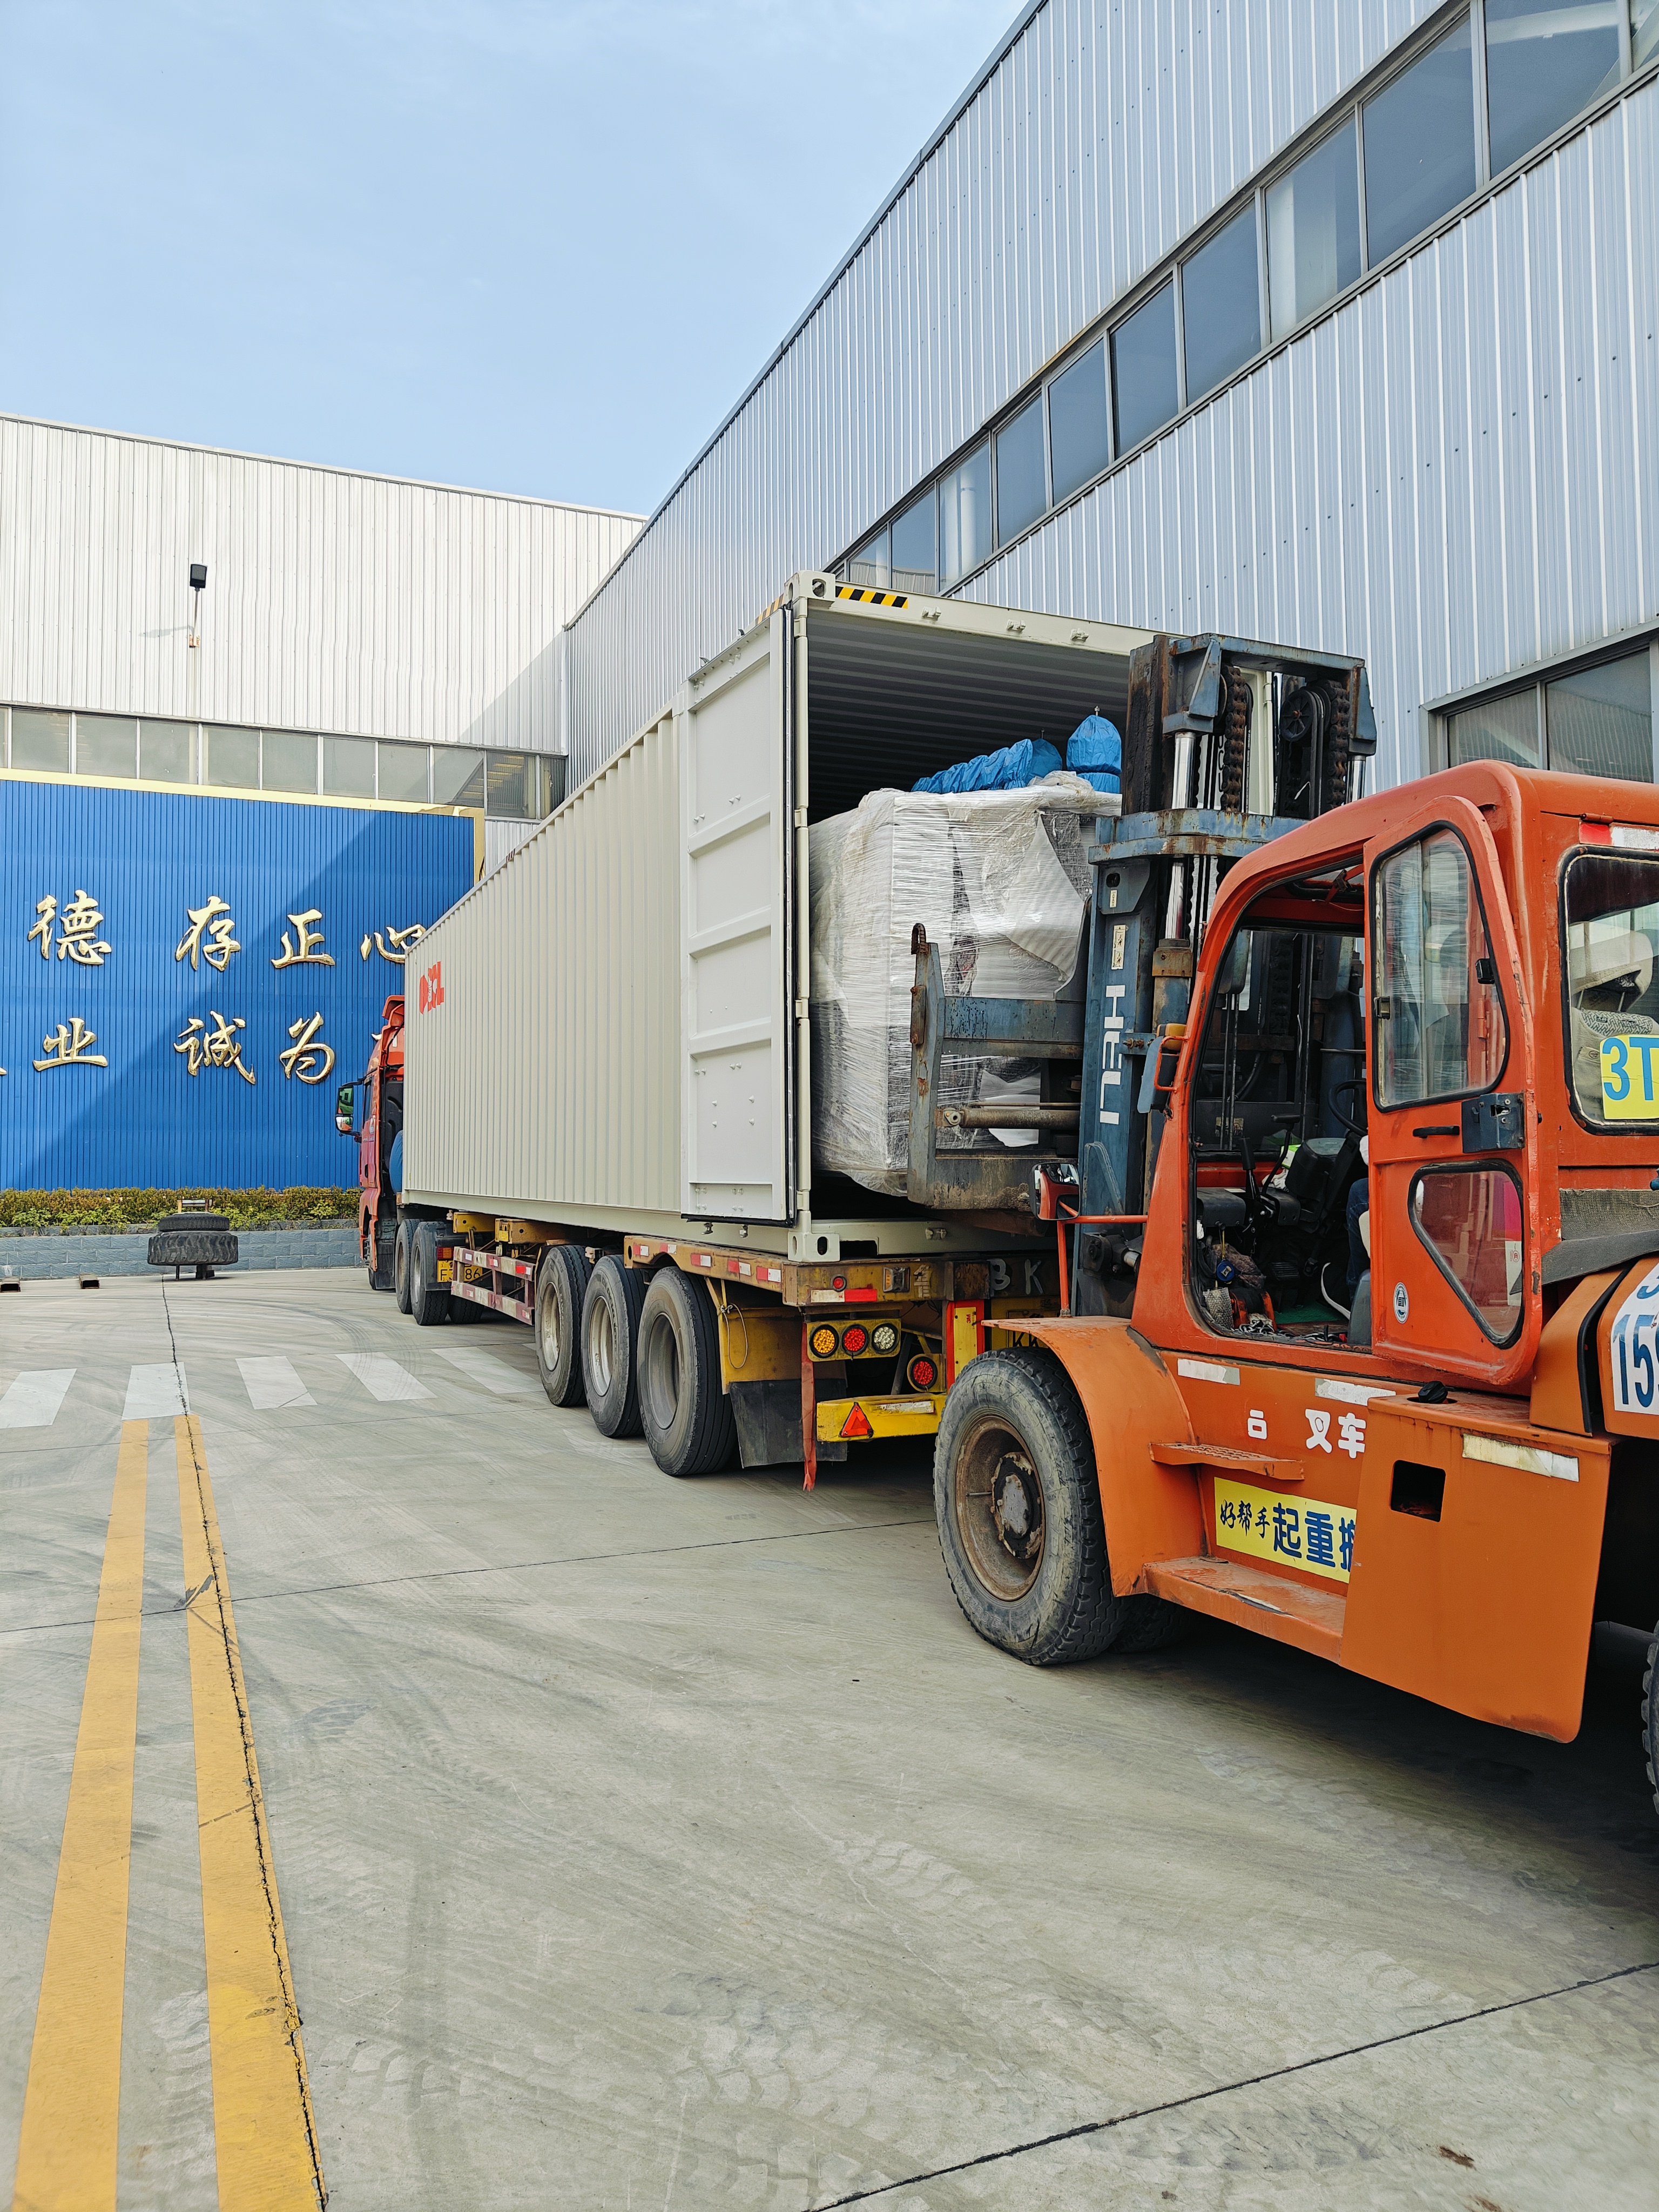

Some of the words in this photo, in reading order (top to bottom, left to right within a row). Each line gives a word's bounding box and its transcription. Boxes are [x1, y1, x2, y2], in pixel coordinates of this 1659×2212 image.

[28, 889, 112, 965] 德
[0, 1017, 108, 1072] 业
[173, 1009, 382, 1084] 诚为
[1100, 984, 1125, 1125] HELI
[1602, 1037, 1659, 1101] 3T
[1613, 1314, 1659, 1408] 15
[1304, 1408, 1367, 1459] 叉车
